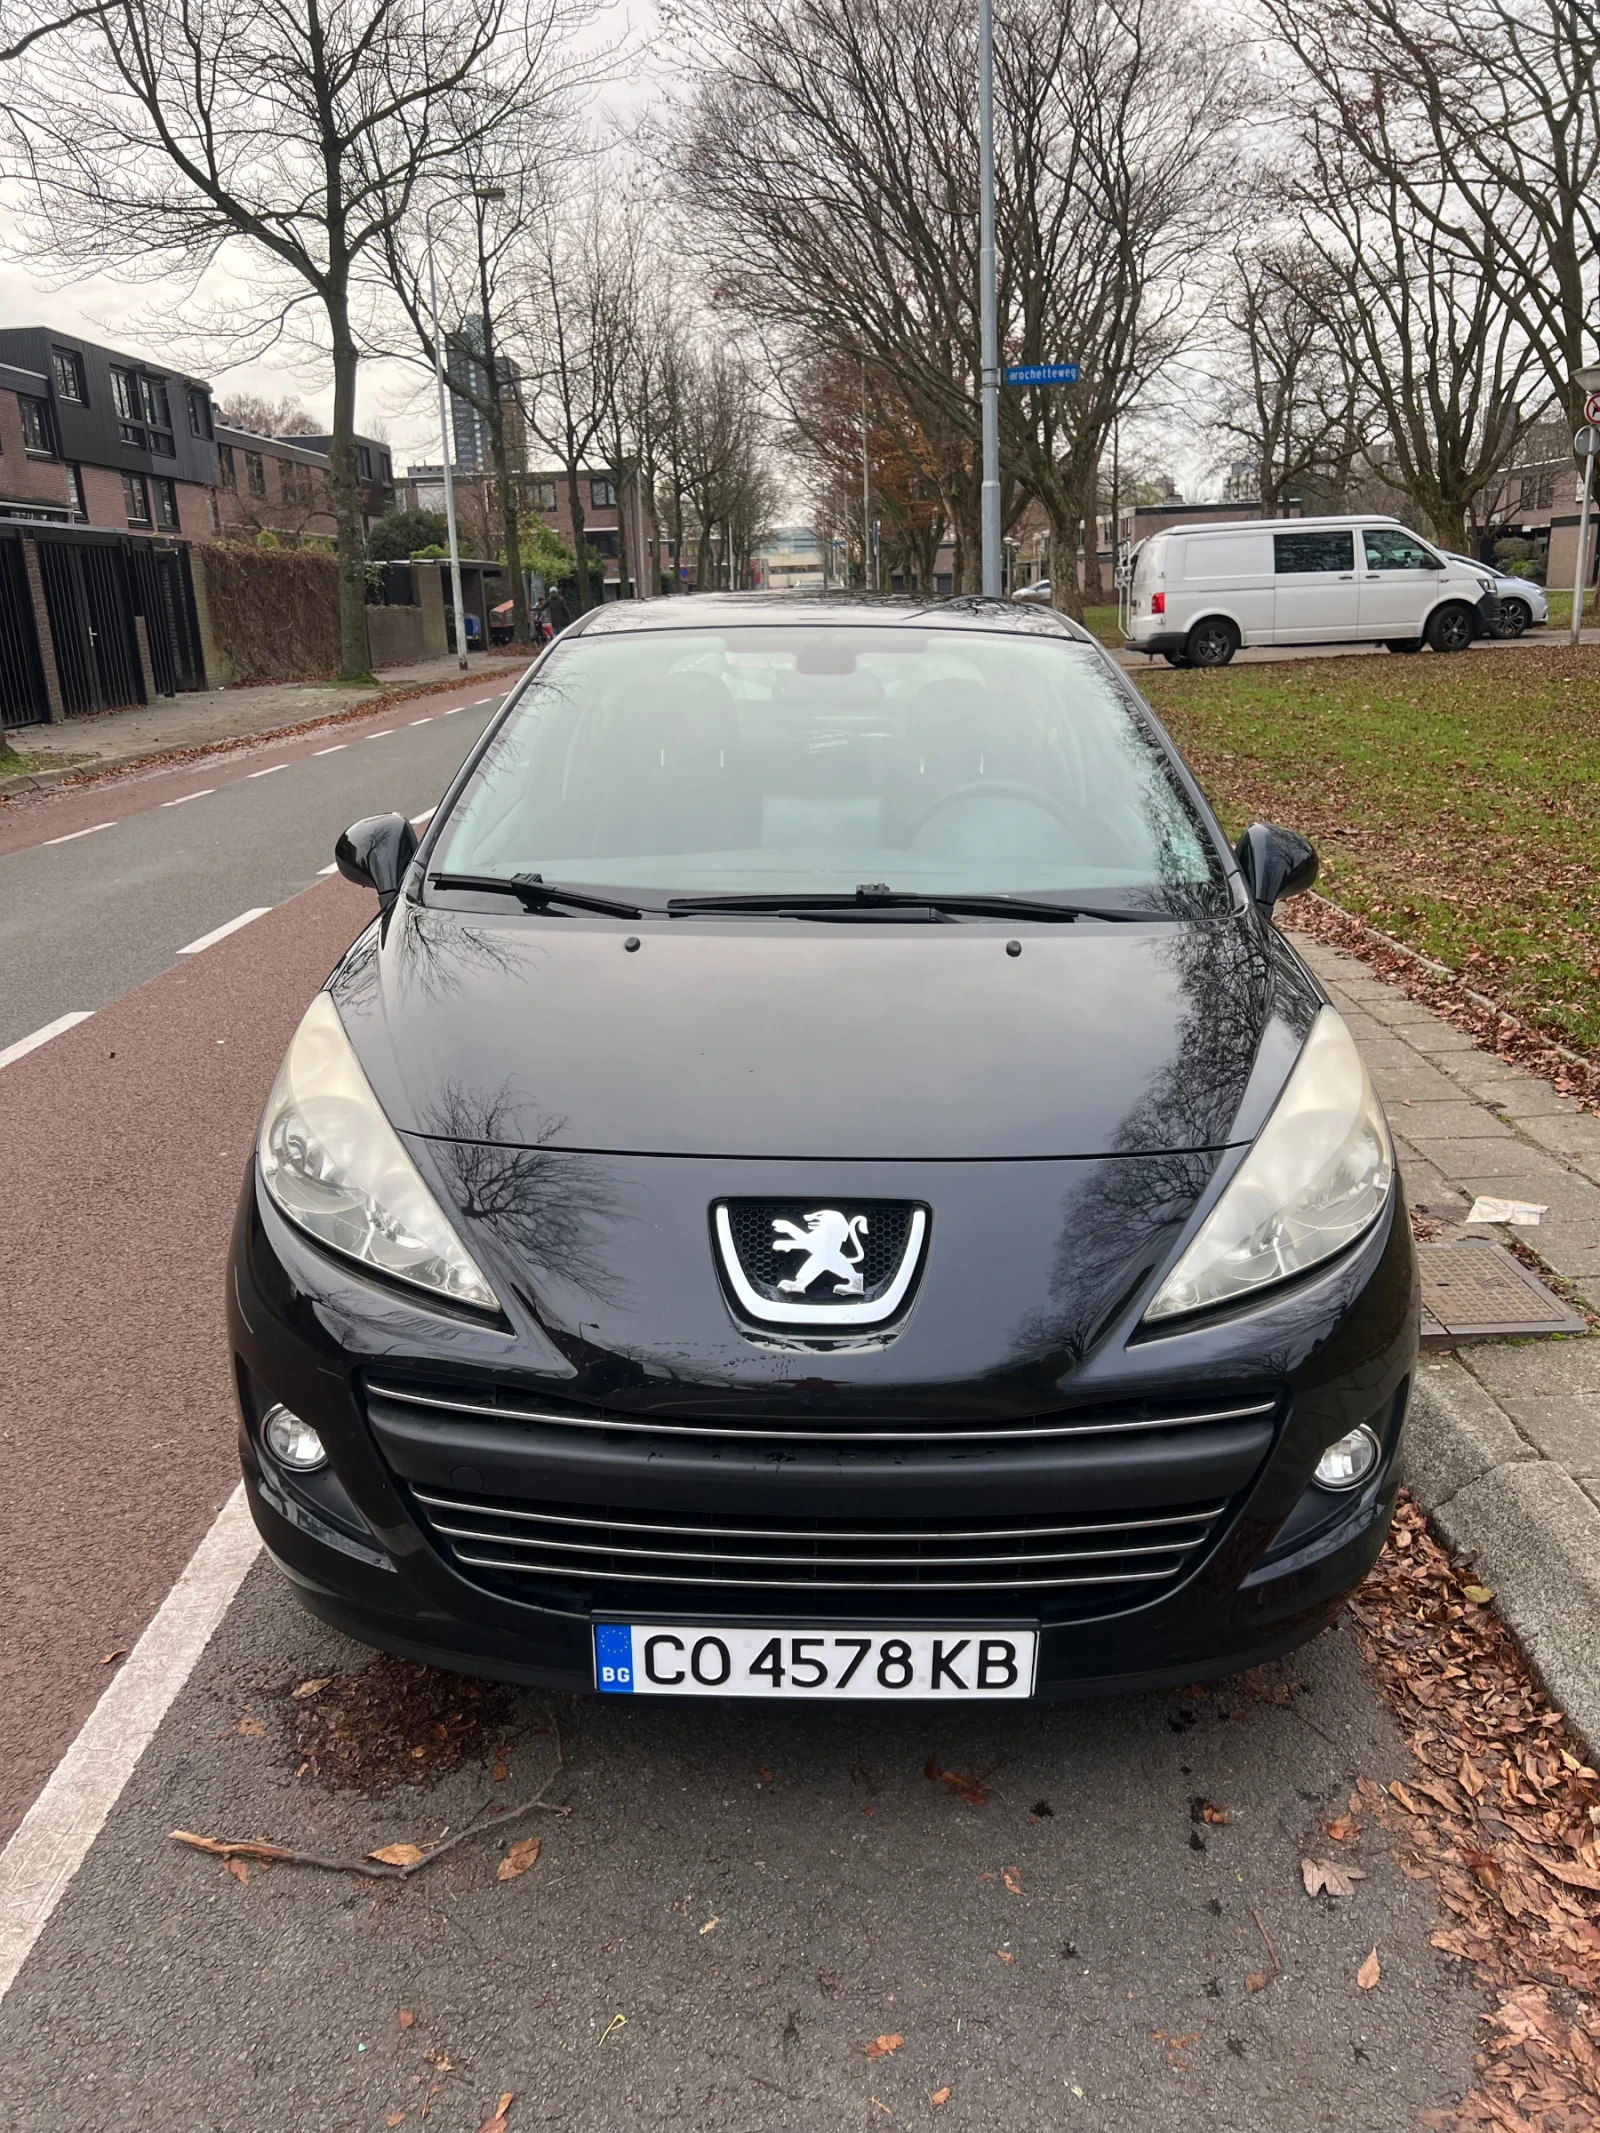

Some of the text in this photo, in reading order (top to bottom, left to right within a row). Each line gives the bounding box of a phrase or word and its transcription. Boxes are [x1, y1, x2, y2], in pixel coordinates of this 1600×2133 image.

[602, 1666, 630, 1683] BG
[644, 1634, 1018, 1690] CO 4578 KB
